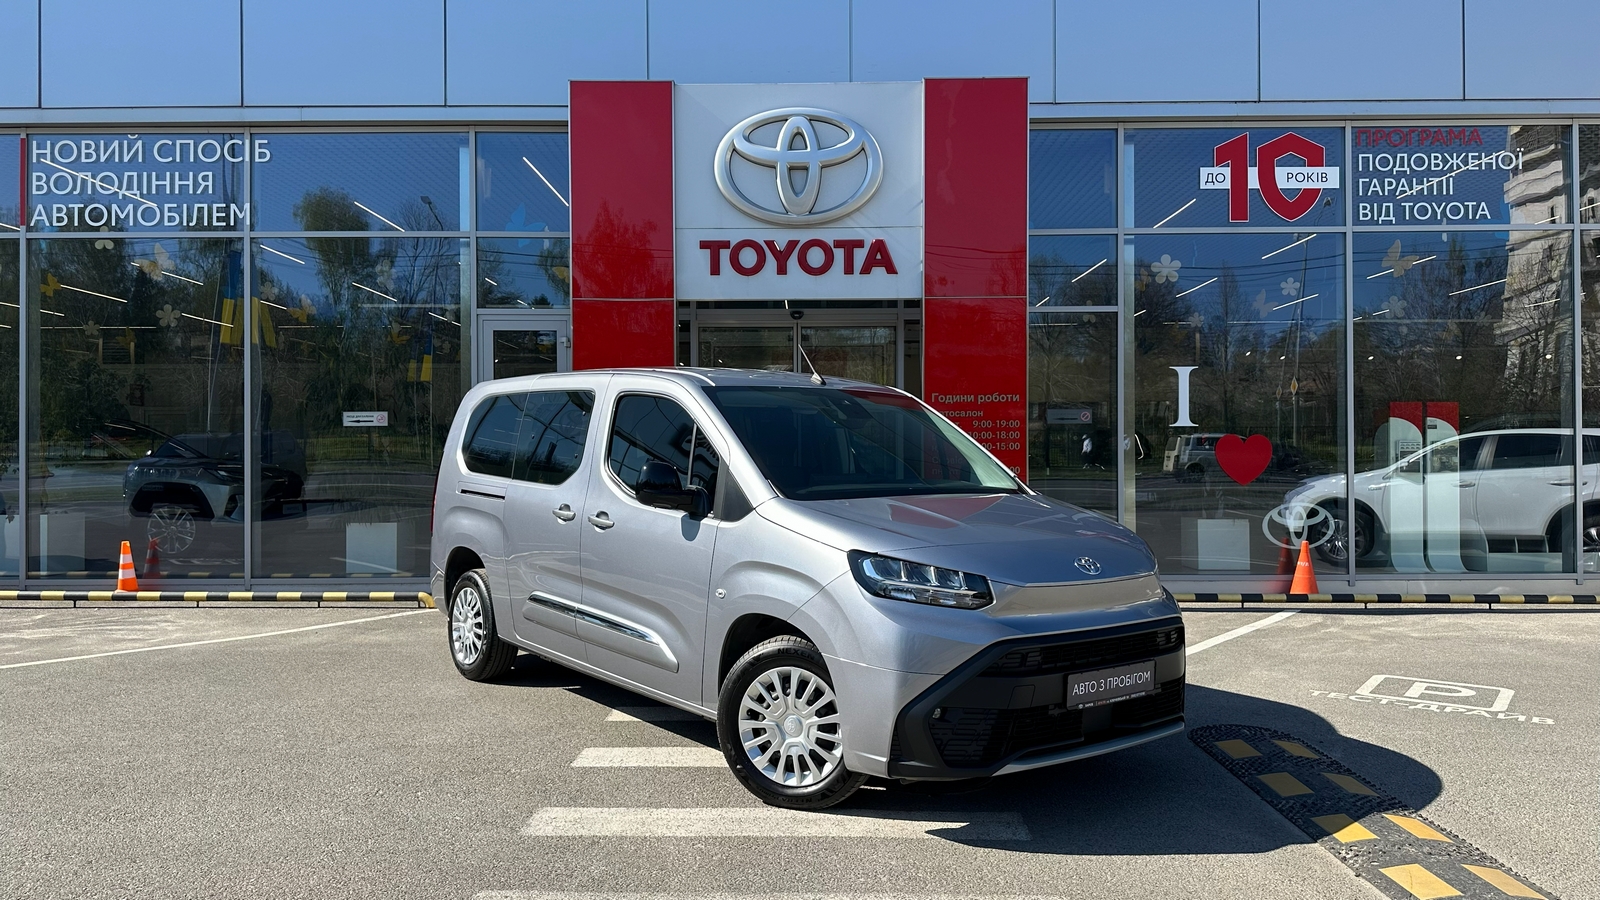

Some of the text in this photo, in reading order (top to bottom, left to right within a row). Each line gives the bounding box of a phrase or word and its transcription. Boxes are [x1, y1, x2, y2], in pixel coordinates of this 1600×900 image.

[31, 135, 271, 163] НОВИЙ СПОСІБ
[1357, 128, 1482, 146] ПРОГРАМА
[1358, 148, 1523, 173] ПОДОВЖЕНОЇ
[31, 171, 213, 199] ВОЛОДІННЯ
[1205, 132, 1328, 222] ДО 10 РОКІВ
[1358, 173, 1454, 197] ГАРАНТІЇ
[30, 203, 251, 227] АВТОМОБІЛЕМ
[1358, 202, 1490, 224] ВІД TOYOTA
[700, 238, 898, 277] TOYOTA
[931, 393, 1020, 404] Години роботи
[972, 420, 1020, 428] 9:00-19:00
[777, 647, 816, 661] NEXEN
[1072, 680, 1097, 696] АВТО
[1106, 670, 1151, 690] ПРОБІГОМ
[1403, 681, 1477, 699] P
[1308, 689, 1556, 725] ТЕСТ-ДРАЙВ
